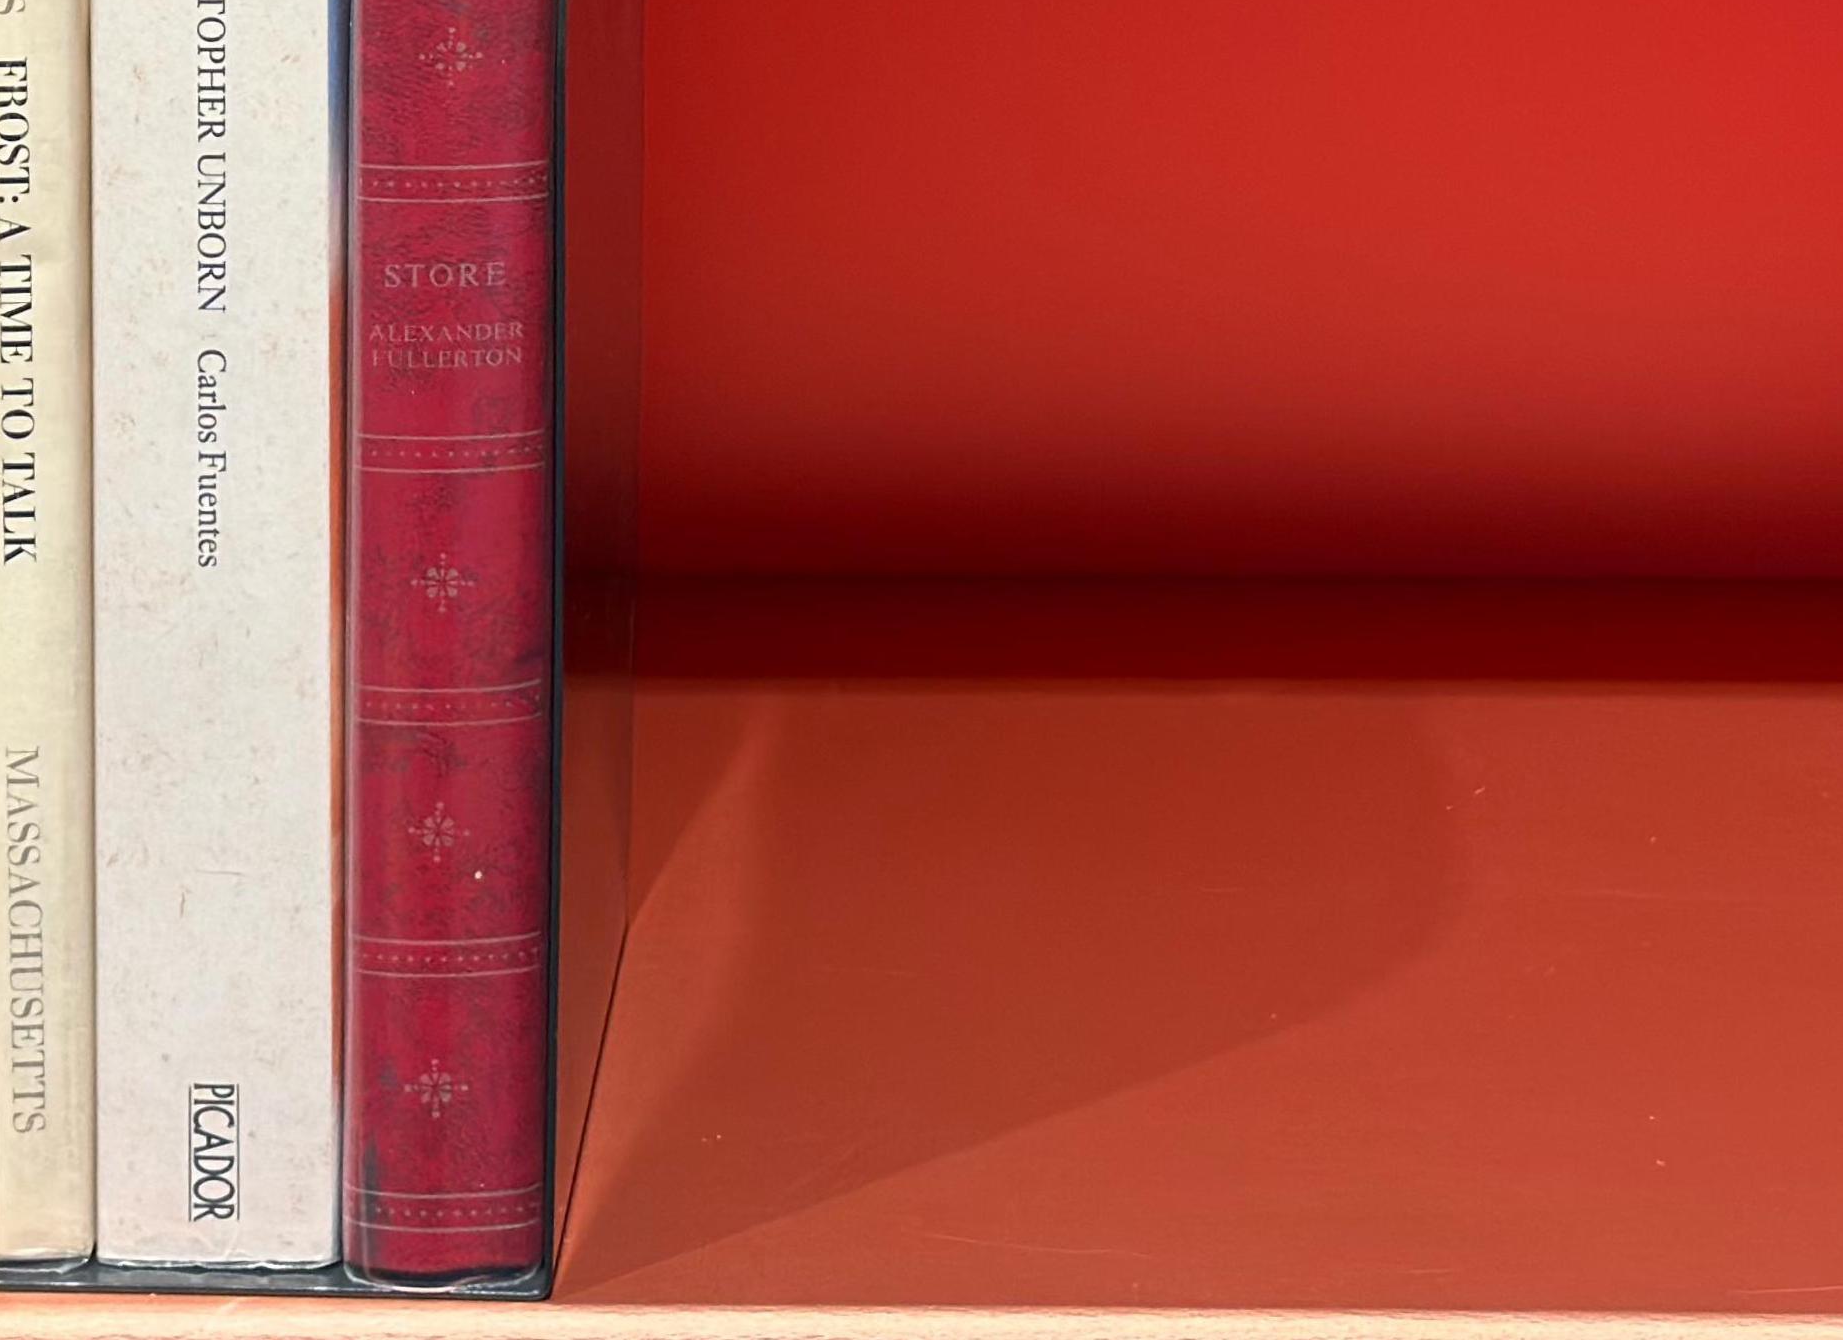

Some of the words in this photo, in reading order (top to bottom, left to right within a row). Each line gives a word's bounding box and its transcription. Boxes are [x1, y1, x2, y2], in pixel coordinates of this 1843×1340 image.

[196, 152, 227, 313] UNBORN
[384, 261, 506, 288] STORE
[369, 322, 524, 343] ALEXANDER
[372, 347, 522, 368] FULLERTON
[0, 377, 36, 440] TO
[197, 349, 227, 444] Carlos
[2, 453, 37, 565] TALK
[197, 451, 227, 568] Fuentes
[5, 745, 47, 1134] MASSACHUSETTS
[192, 1083, 235, 1221] PICADOR
